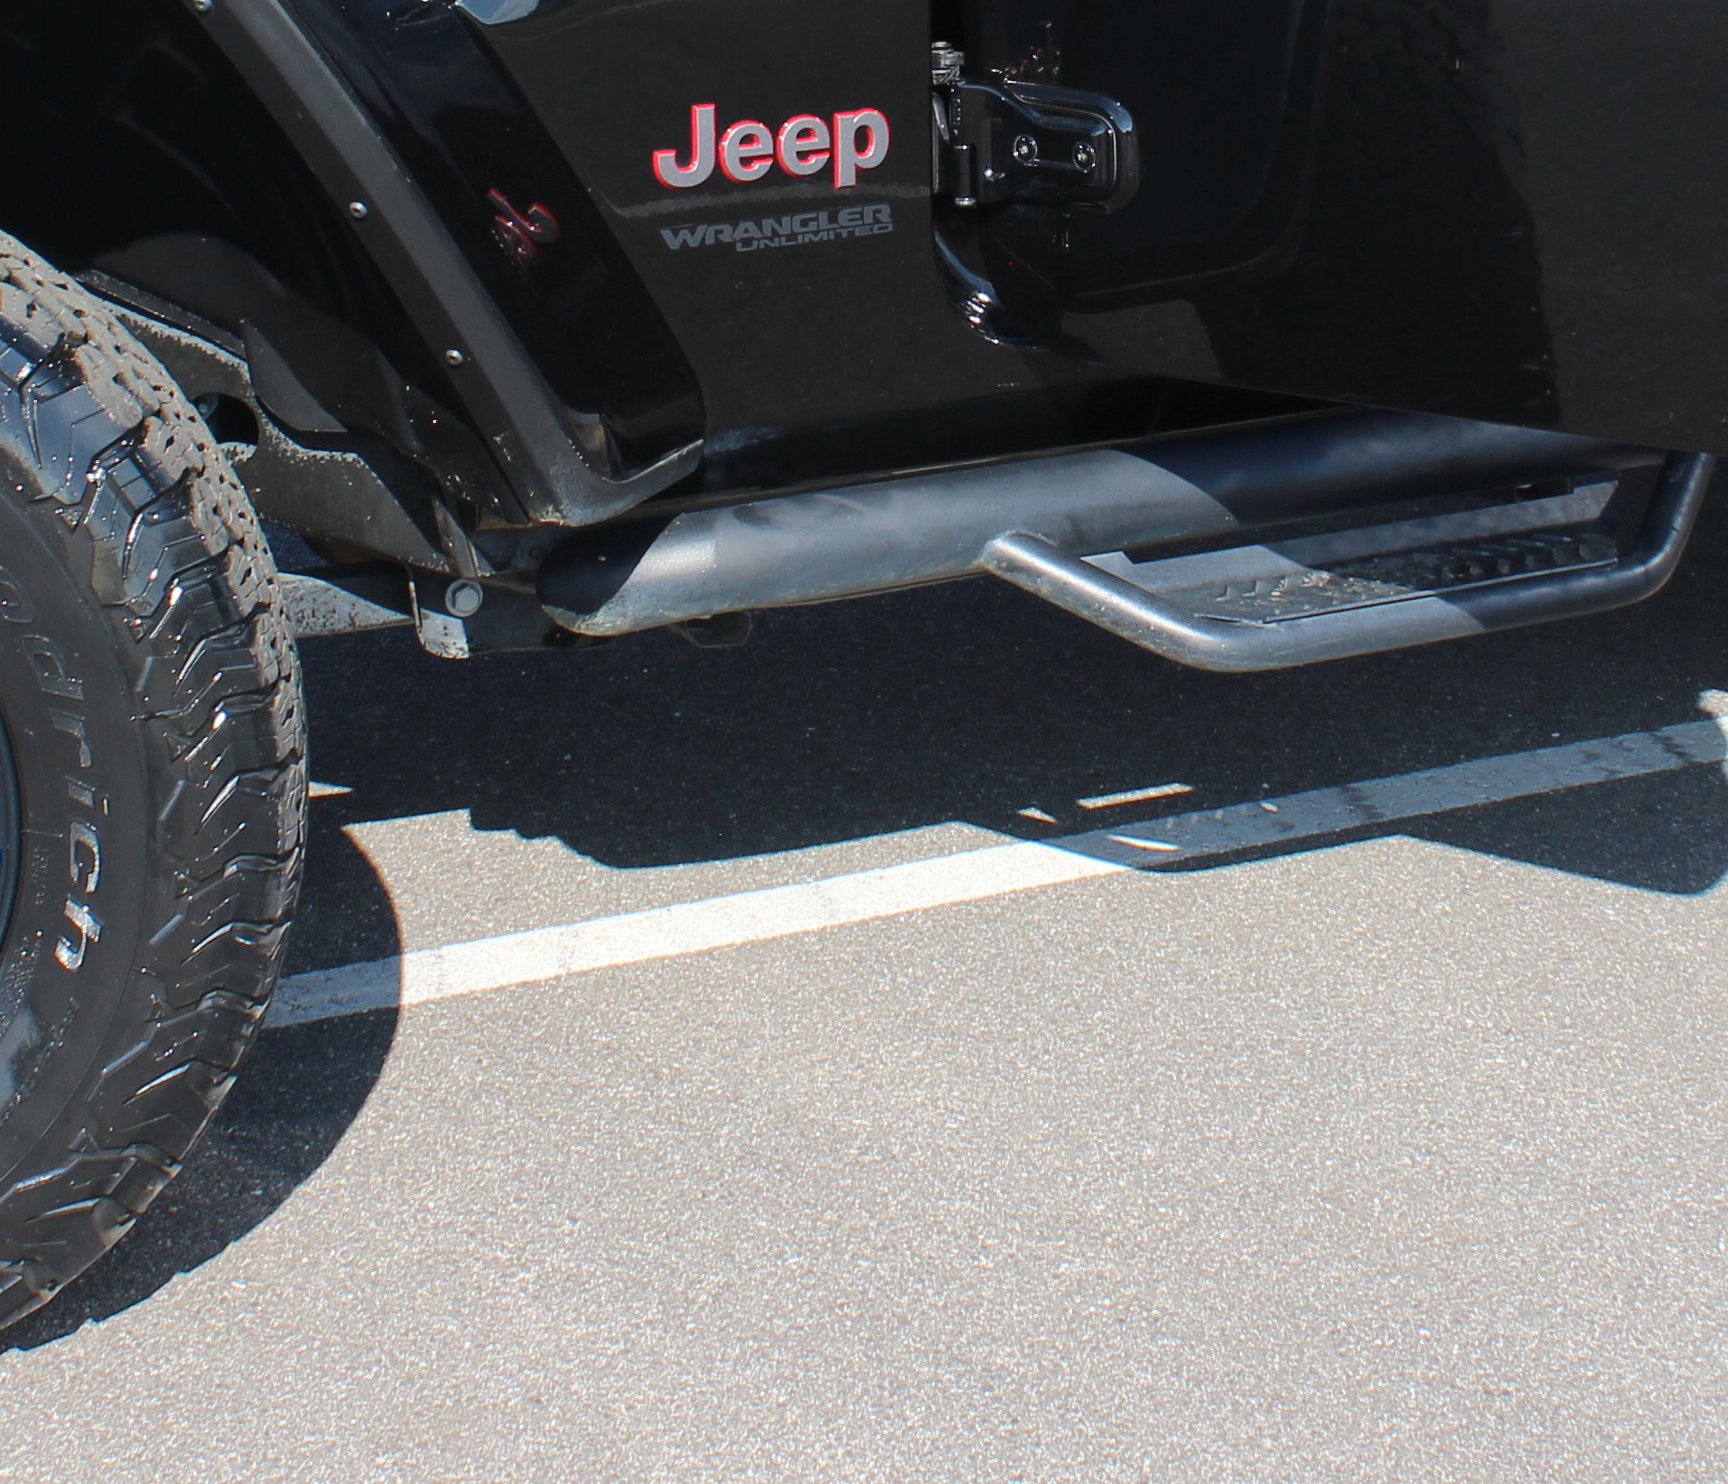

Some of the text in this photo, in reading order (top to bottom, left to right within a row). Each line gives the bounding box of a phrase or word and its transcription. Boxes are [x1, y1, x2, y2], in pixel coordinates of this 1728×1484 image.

[651, 102, 892, 189] Jeep
[660, 204, 891, 250] WRANGLER
[735, 222, 894, 252] UNLIMITED
